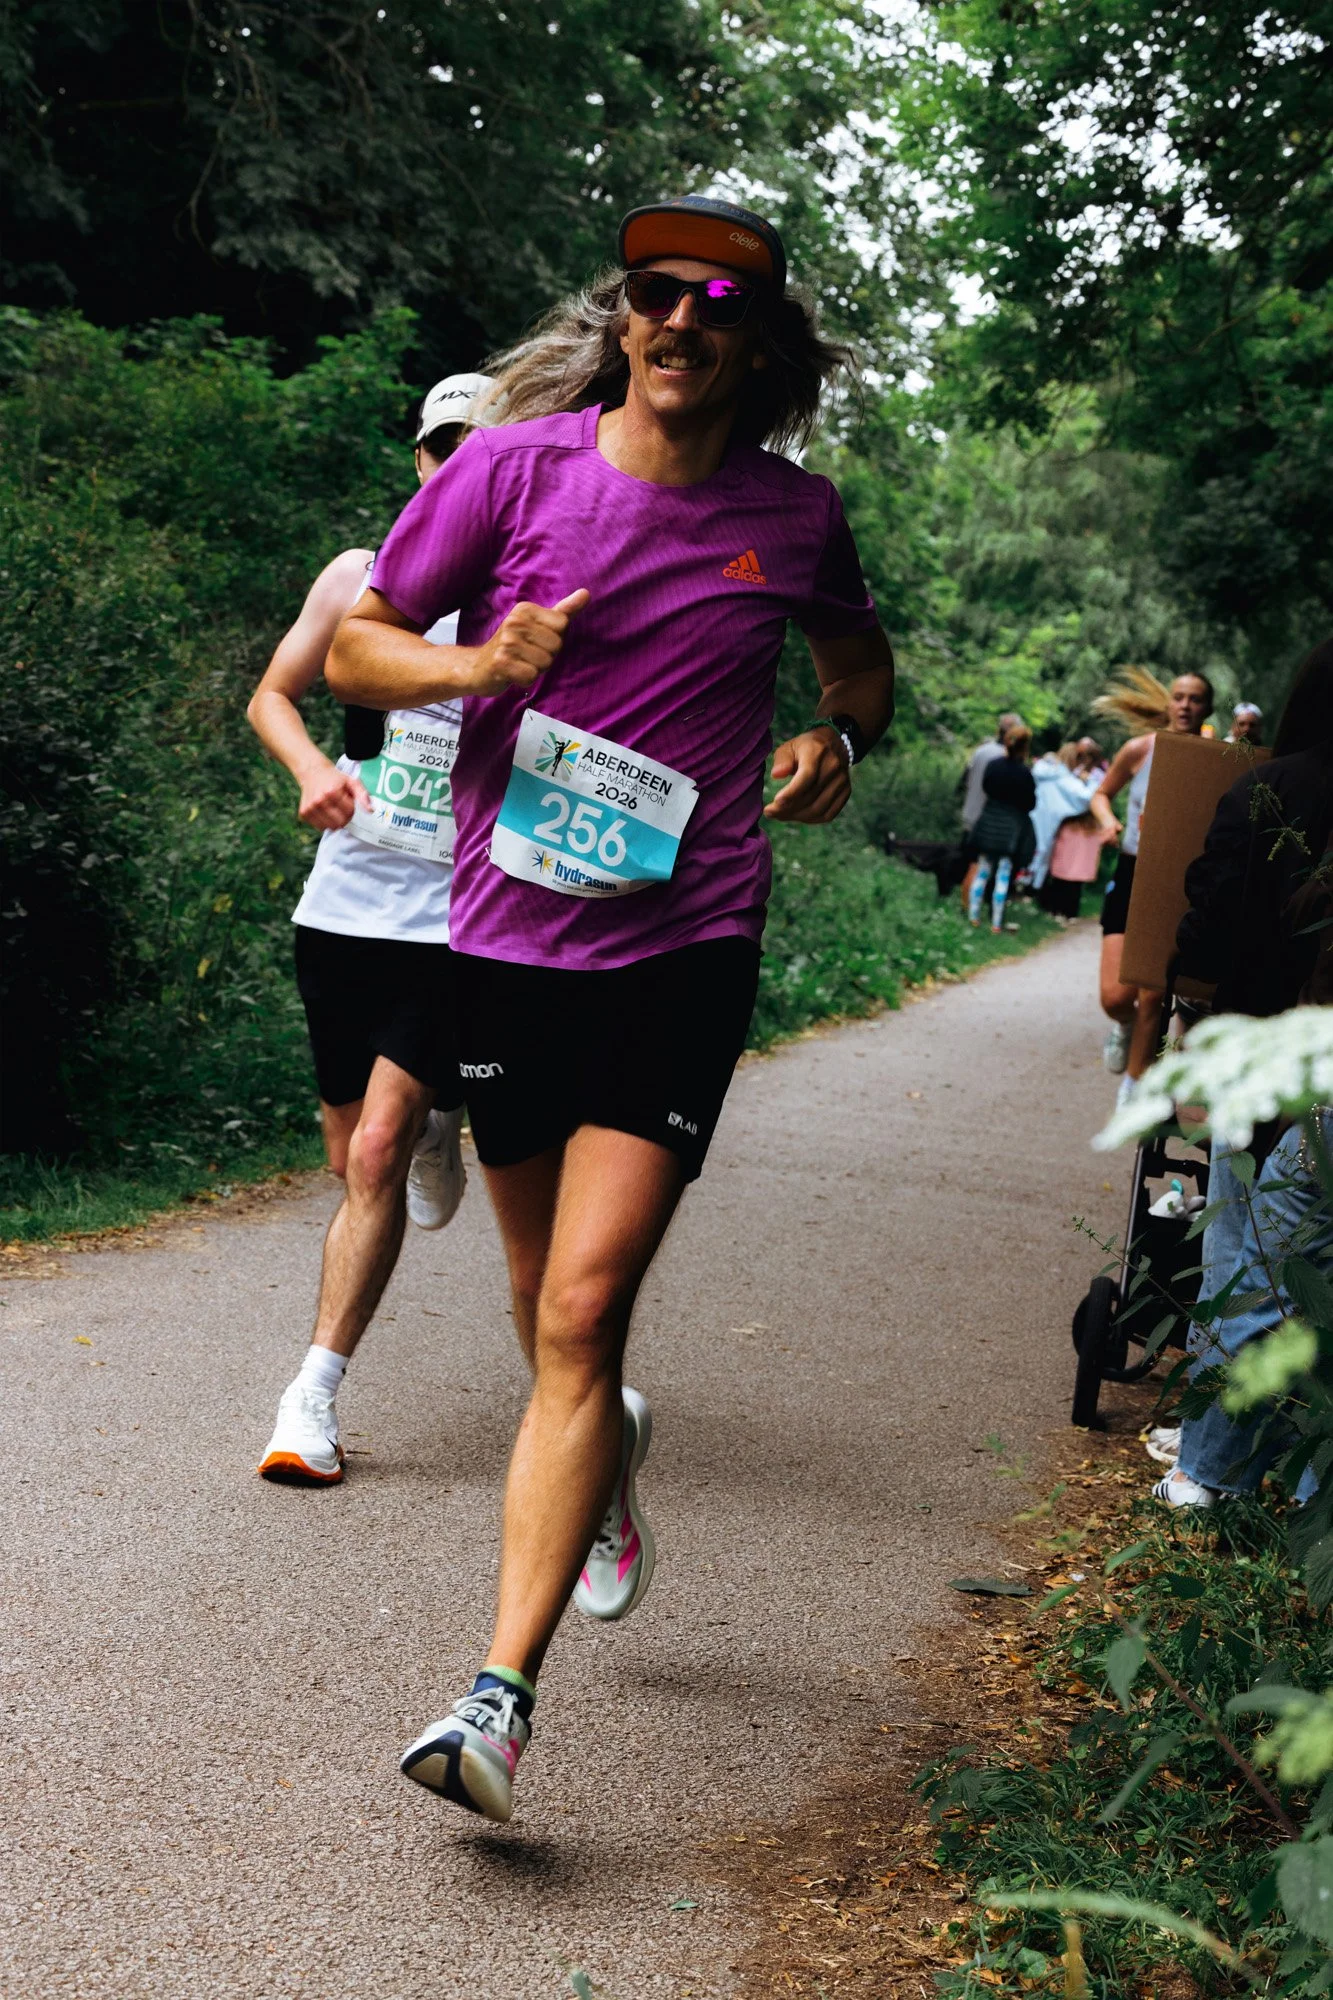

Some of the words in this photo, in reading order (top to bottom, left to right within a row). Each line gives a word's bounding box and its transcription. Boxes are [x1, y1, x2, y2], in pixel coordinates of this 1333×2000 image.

[722, 567, 767, 585] adidas
[406, 731, 460, 751] ABERDE
[418, 754, 450, 769] 2026
[582, 748, 673, 796] ABERDEEN
[375, 759, 453, 812] 1042
[577, 762, 605, 778] HALF
[606, 773, 667, 807] MARATHON
[595, 782, 638, 810] 2026
[391, 812, 438, 833] hydrasun
[533, 792, 627, 867] 256
[439, 850, 455, 859] 104
[554, 860, 618, 891] hydrasun
